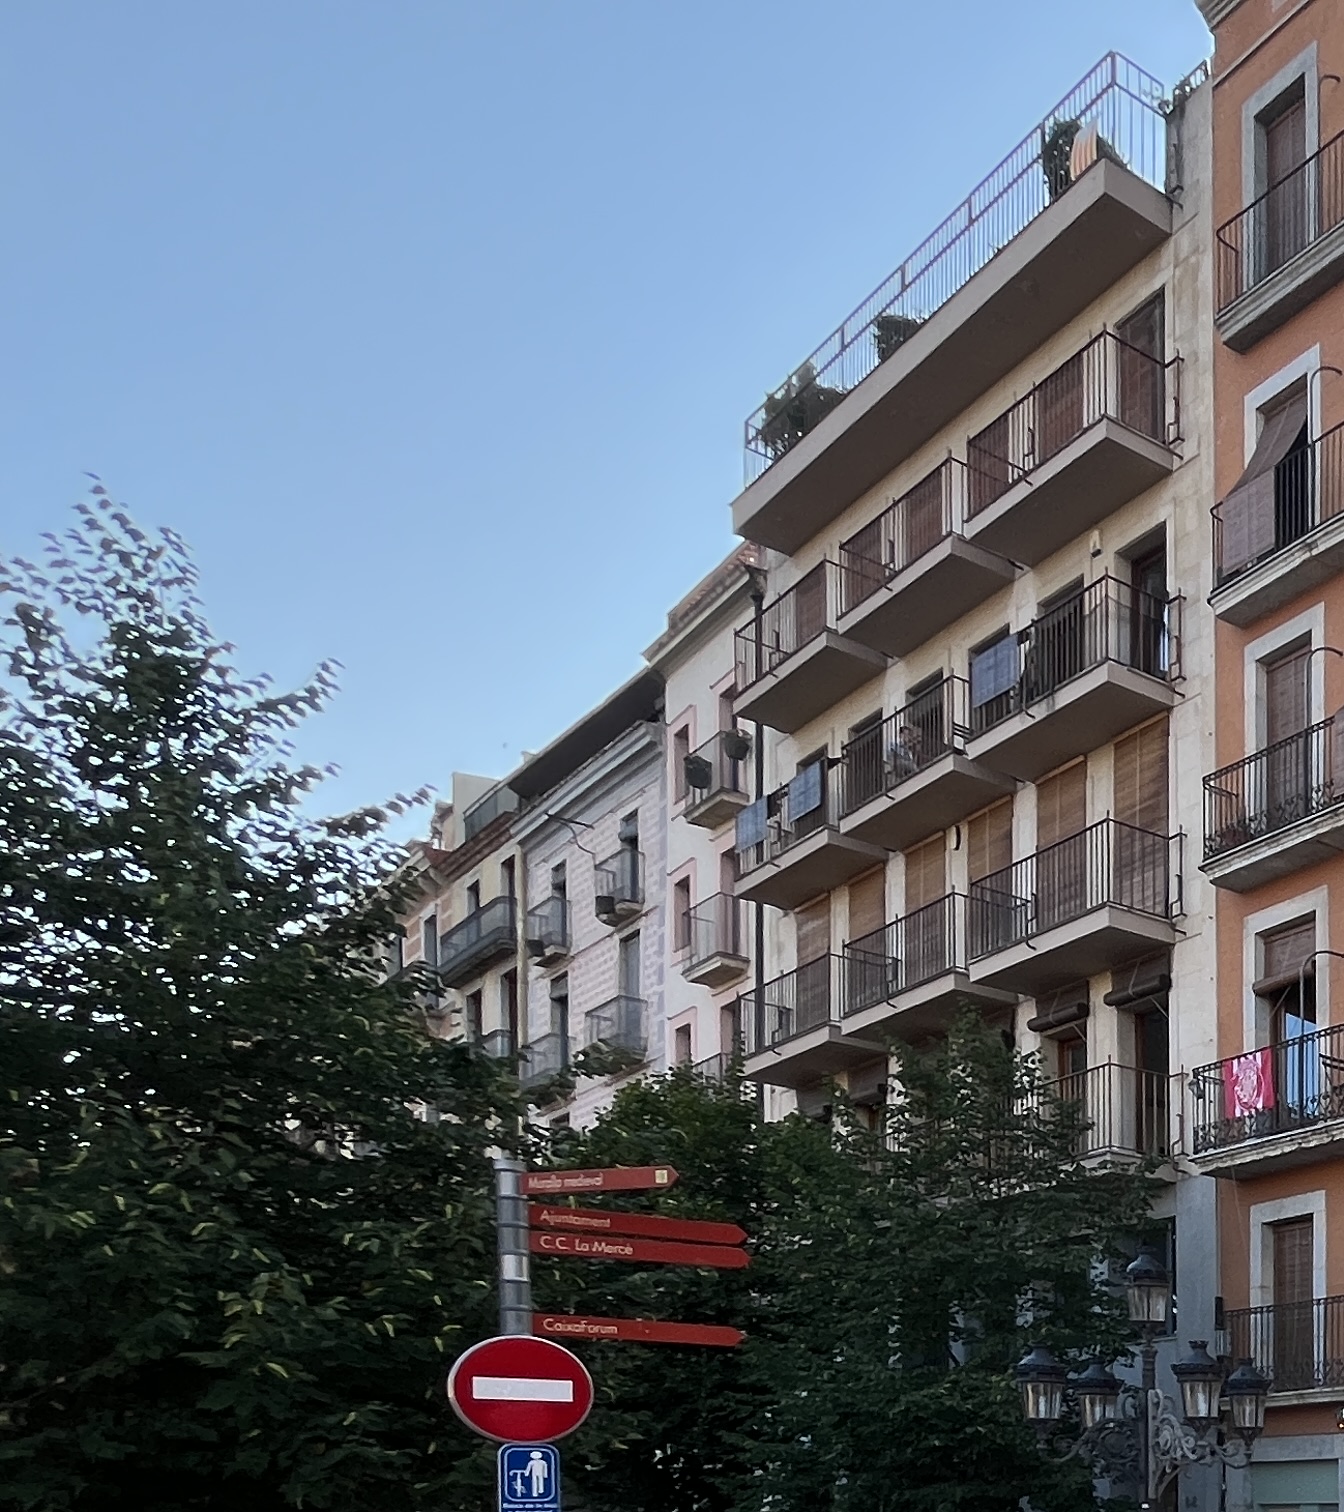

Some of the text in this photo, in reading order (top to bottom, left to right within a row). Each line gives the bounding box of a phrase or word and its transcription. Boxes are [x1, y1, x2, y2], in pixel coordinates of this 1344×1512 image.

[540, 1209, 611, 1228] Ajuntament
[574, 1238, 589, 1252] La
[543, 1317, 618, 1334] CaixaForum
